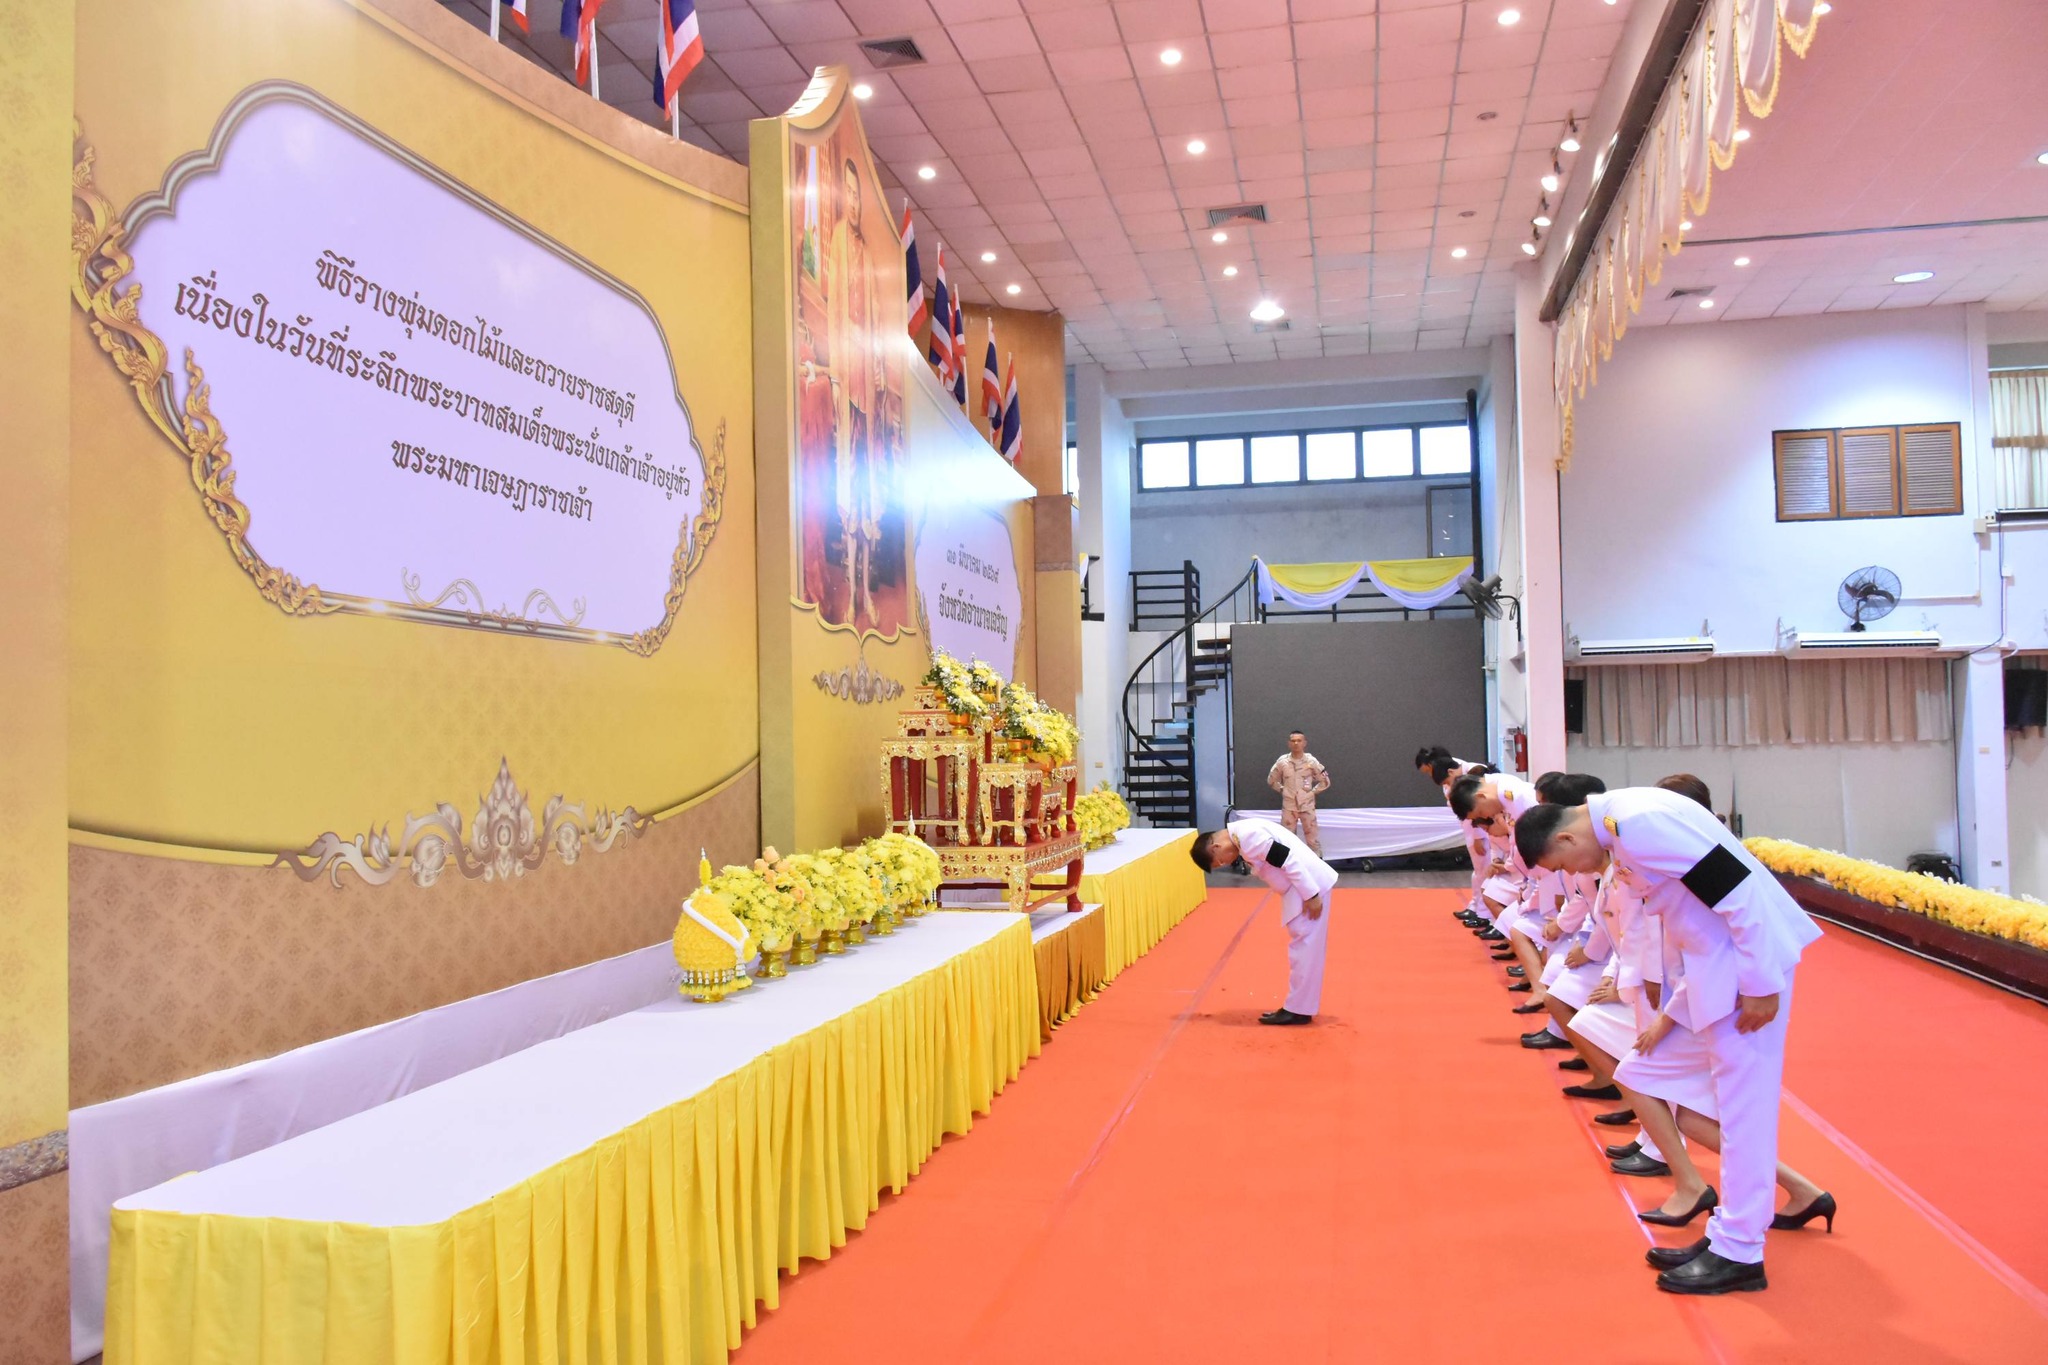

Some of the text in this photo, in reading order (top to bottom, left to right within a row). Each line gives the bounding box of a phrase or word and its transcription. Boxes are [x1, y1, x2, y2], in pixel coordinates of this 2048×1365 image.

[315, 249, 636, 428] พิธีวางพุ่มดอกไม้และถวายราชสดุดี
[174, 270, 691, 501] เนื่องในวันที่ระลึกพระบาทสมเด็จพระนั่งเกล้าเจ้าอยู่หัว
[391, 439, 593, 522] พระมหาเจษฎาราชเจ้า
[959, 543, 981, 575] มีนาคม
[939, 582, 1008, 643] จังหวัดอำนาจเจริญ
